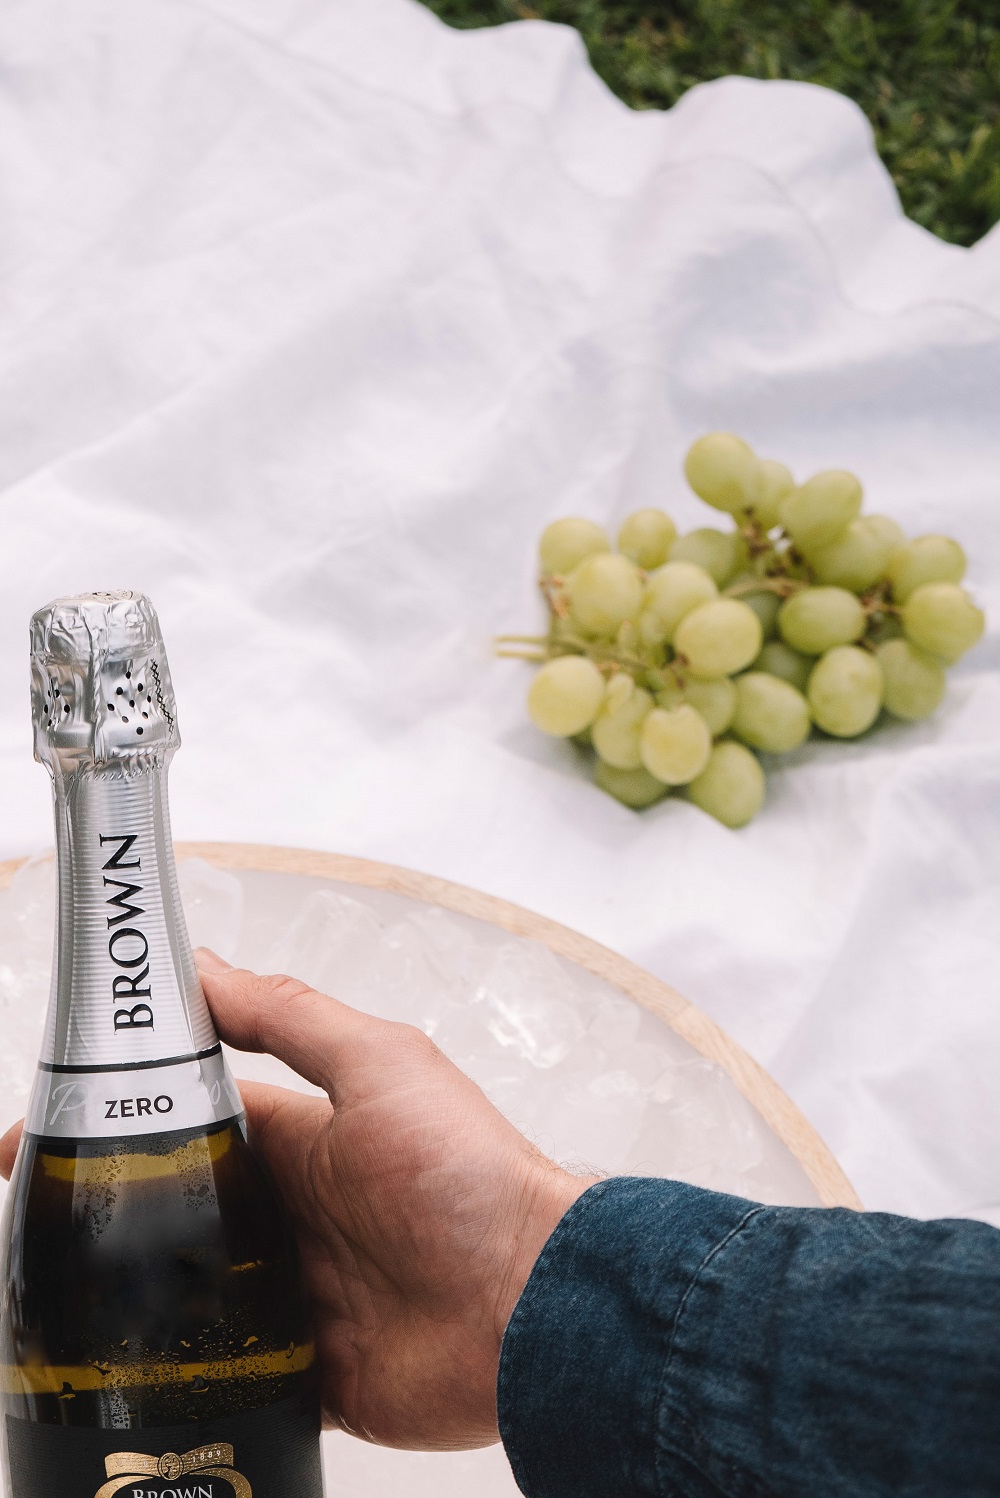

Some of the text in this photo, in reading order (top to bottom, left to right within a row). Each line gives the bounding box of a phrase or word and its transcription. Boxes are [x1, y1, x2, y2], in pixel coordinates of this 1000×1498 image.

[99, 832, 155, 1035] BROWN
[104, 1094, 174, 1119] ZERO
[192, 1449, 221, 1463] 1889
